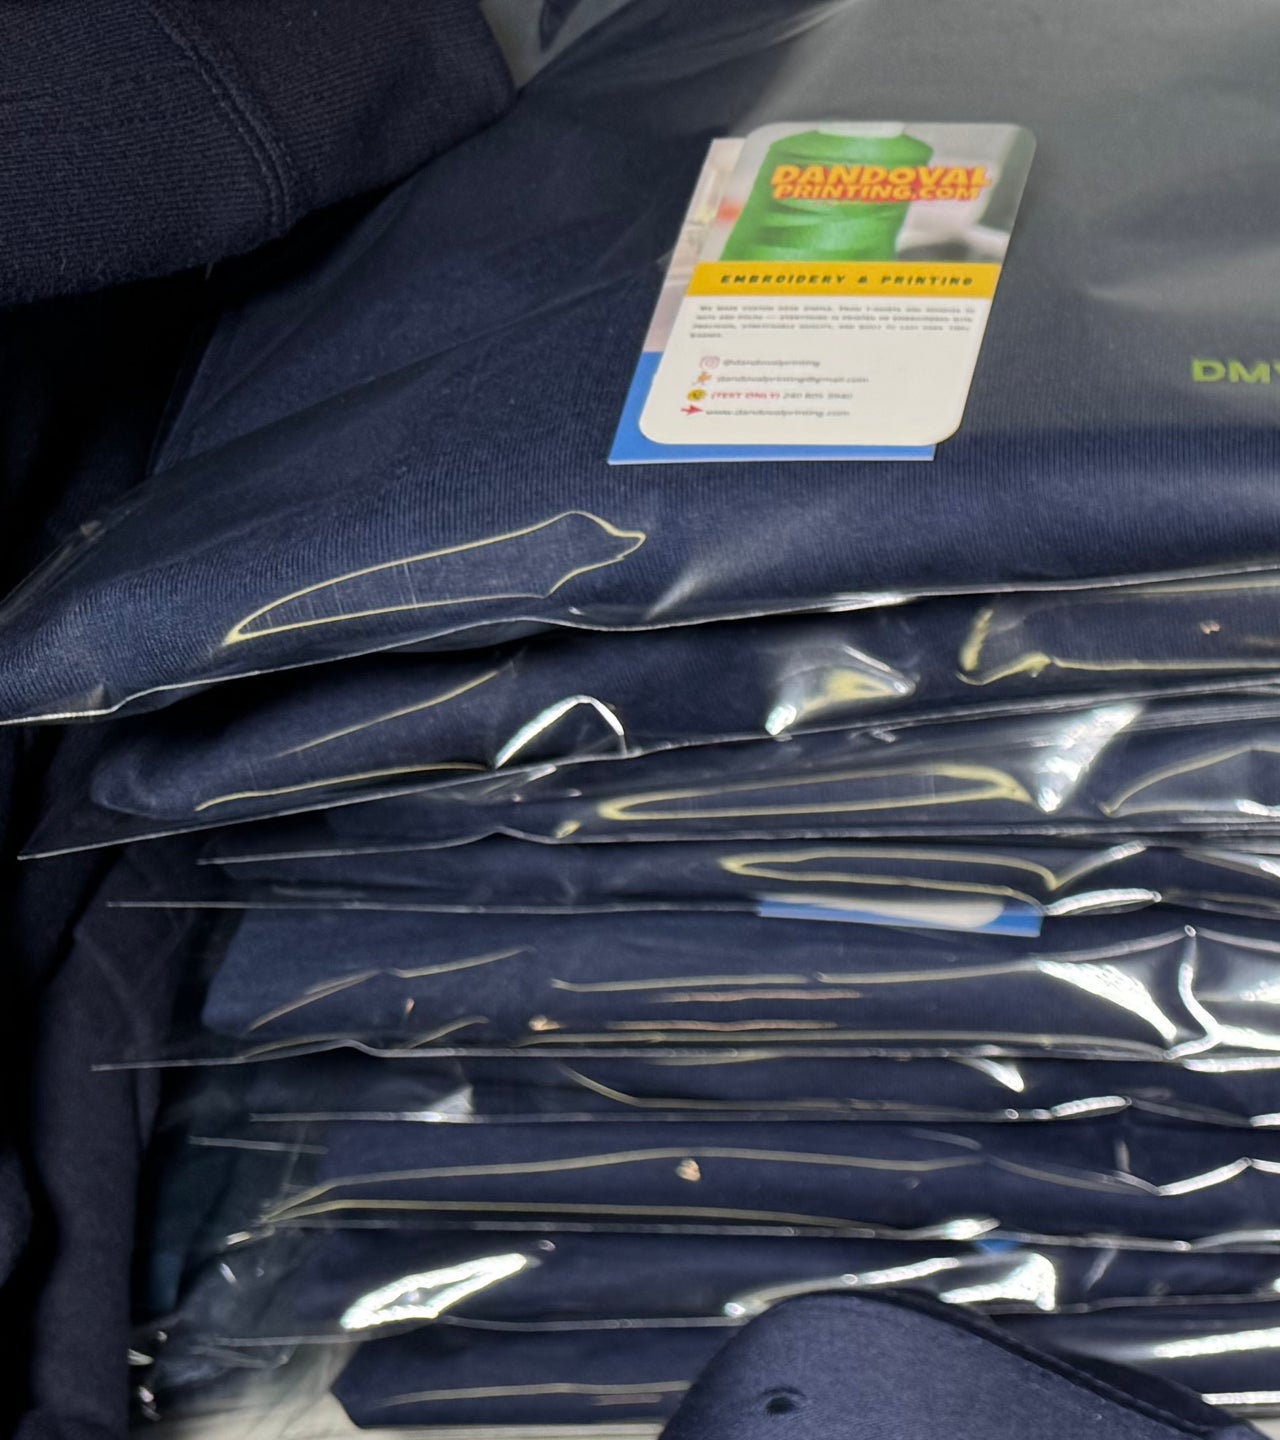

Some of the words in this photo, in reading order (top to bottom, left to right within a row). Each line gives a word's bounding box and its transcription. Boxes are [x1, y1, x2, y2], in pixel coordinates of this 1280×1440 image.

[771, 164, 991, 187] DANDOVAL
[773, 183, 981, 200] PRINTING.COM
[720, 274, 845, 285] EMBROIDERY
[881, 274, 974, 286] PRINTING
